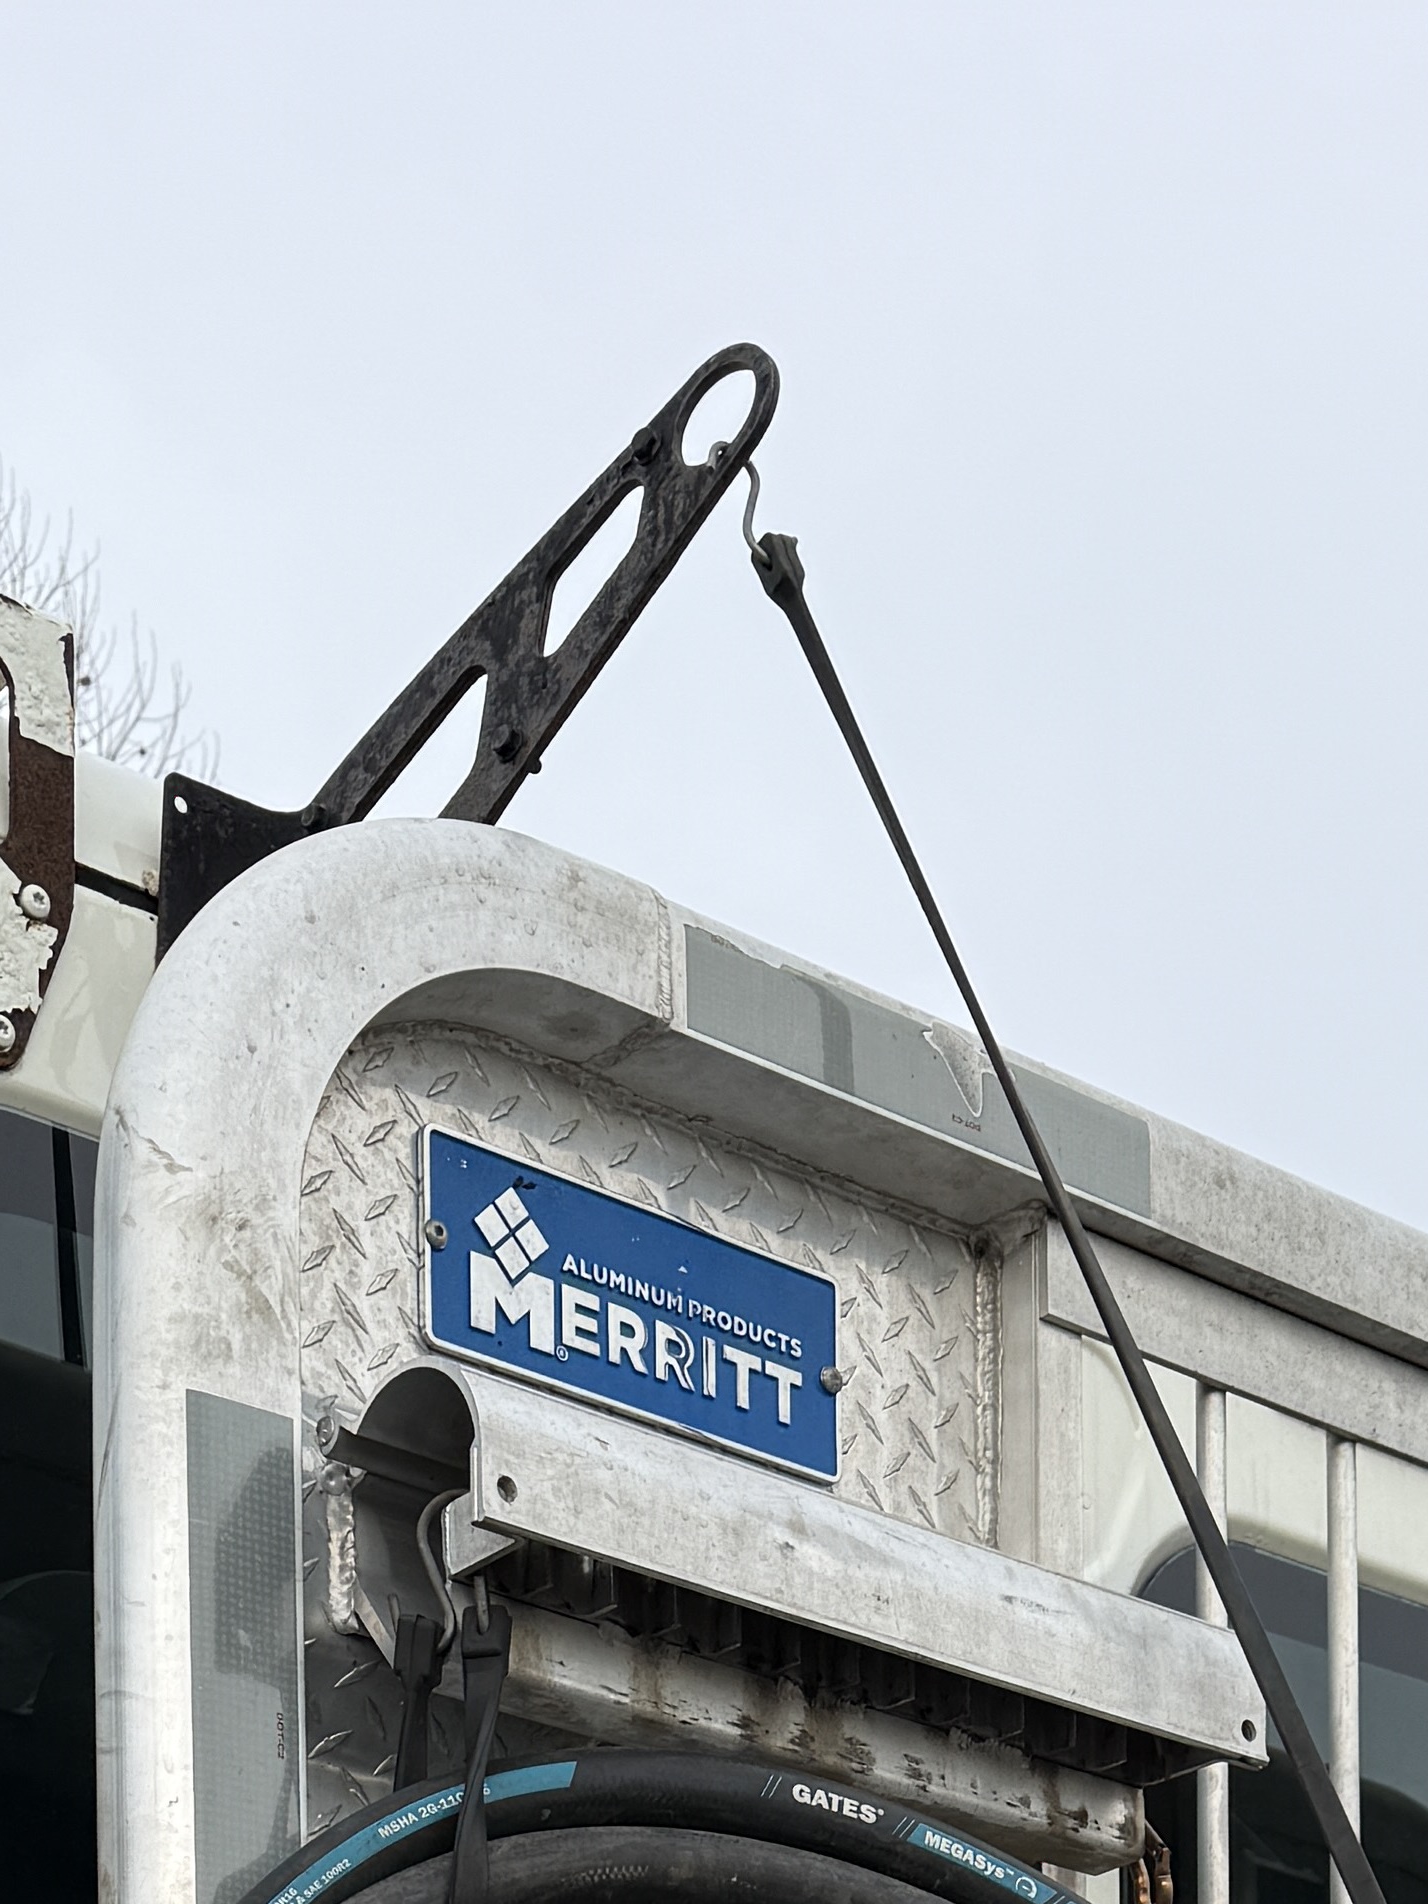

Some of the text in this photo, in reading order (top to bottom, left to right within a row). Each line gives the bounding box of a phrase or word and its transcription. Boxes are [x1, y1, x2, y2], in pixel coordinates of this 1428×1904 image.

[470, 1250, 803, 1425] MERRITT
[562, 1254, 803, 1357] ALUMINUM PRODUCTS
[378, 1812, 419, 1838] MSHA
[304, 1880, 323, 1900] SAE
[322, 1858, 352, 1885] 100R2
